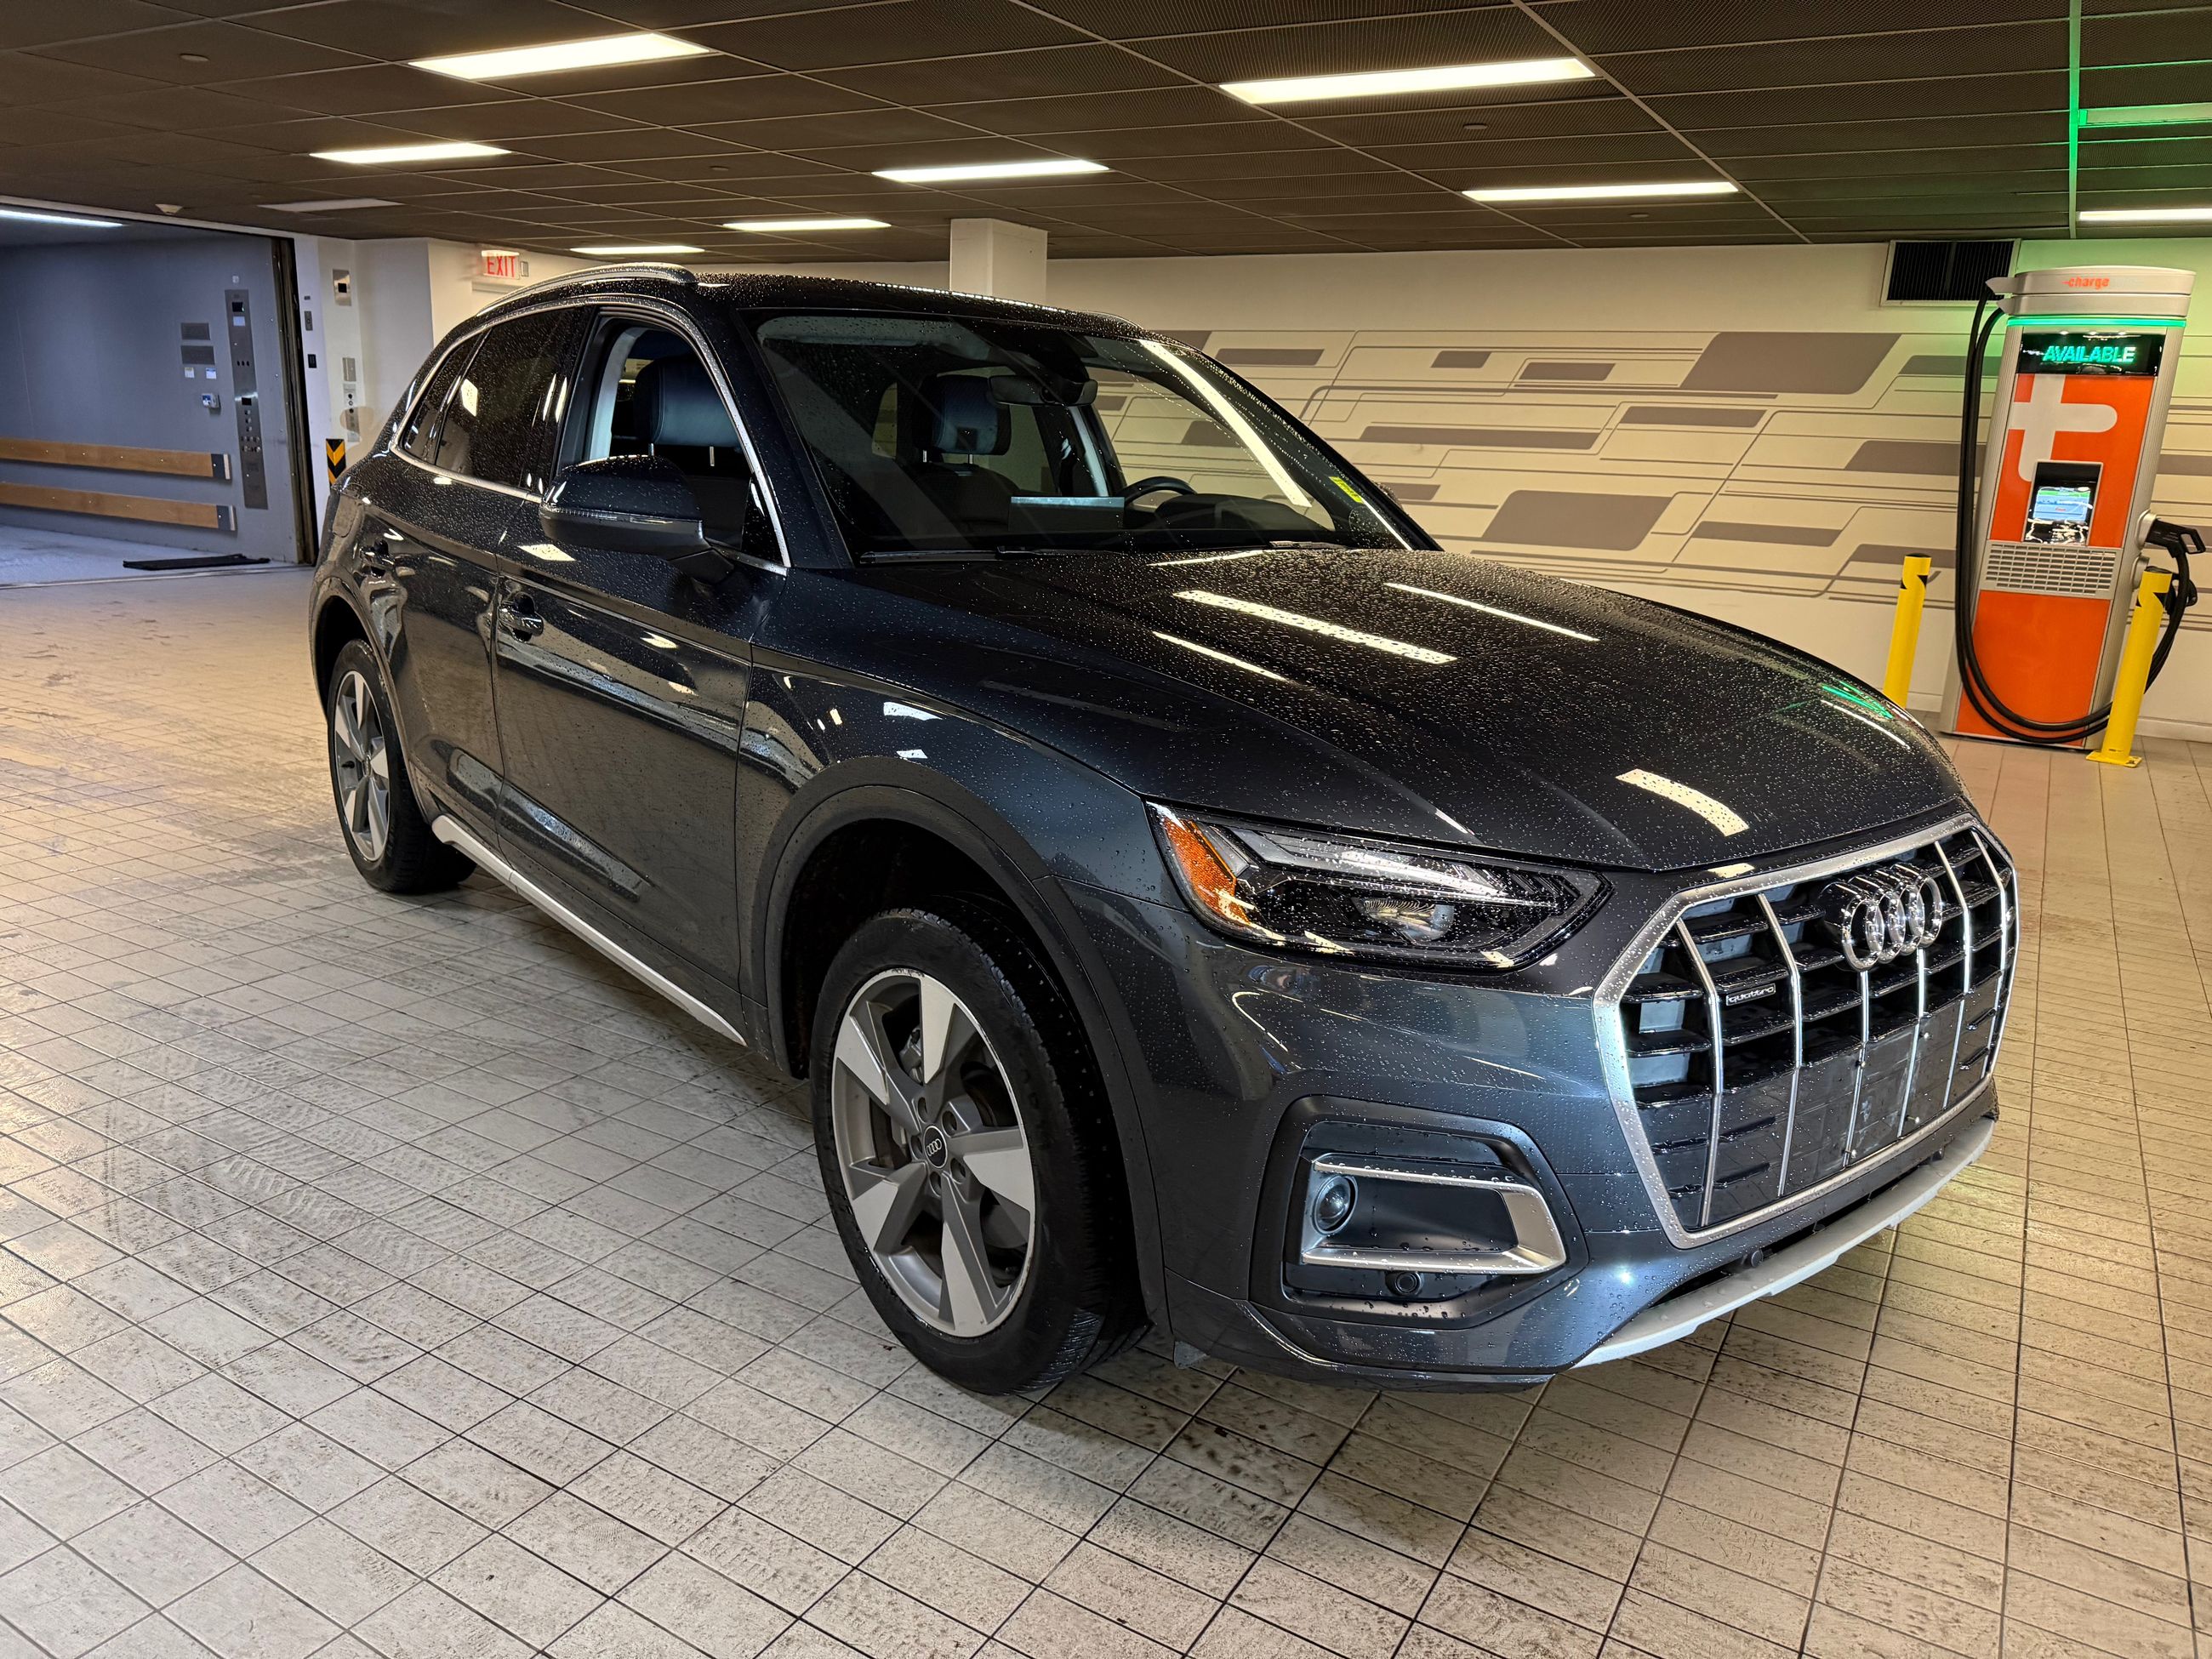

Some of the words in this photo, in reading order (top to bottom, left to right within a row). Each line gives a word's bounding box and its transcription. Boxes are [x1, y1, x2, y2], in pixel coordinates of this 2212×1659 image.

[487, 254, 516, 277] EXIT
[2043, 345, 2136, 362] AVAILABLE
[1728, 986, 1774, 1003] quattro
